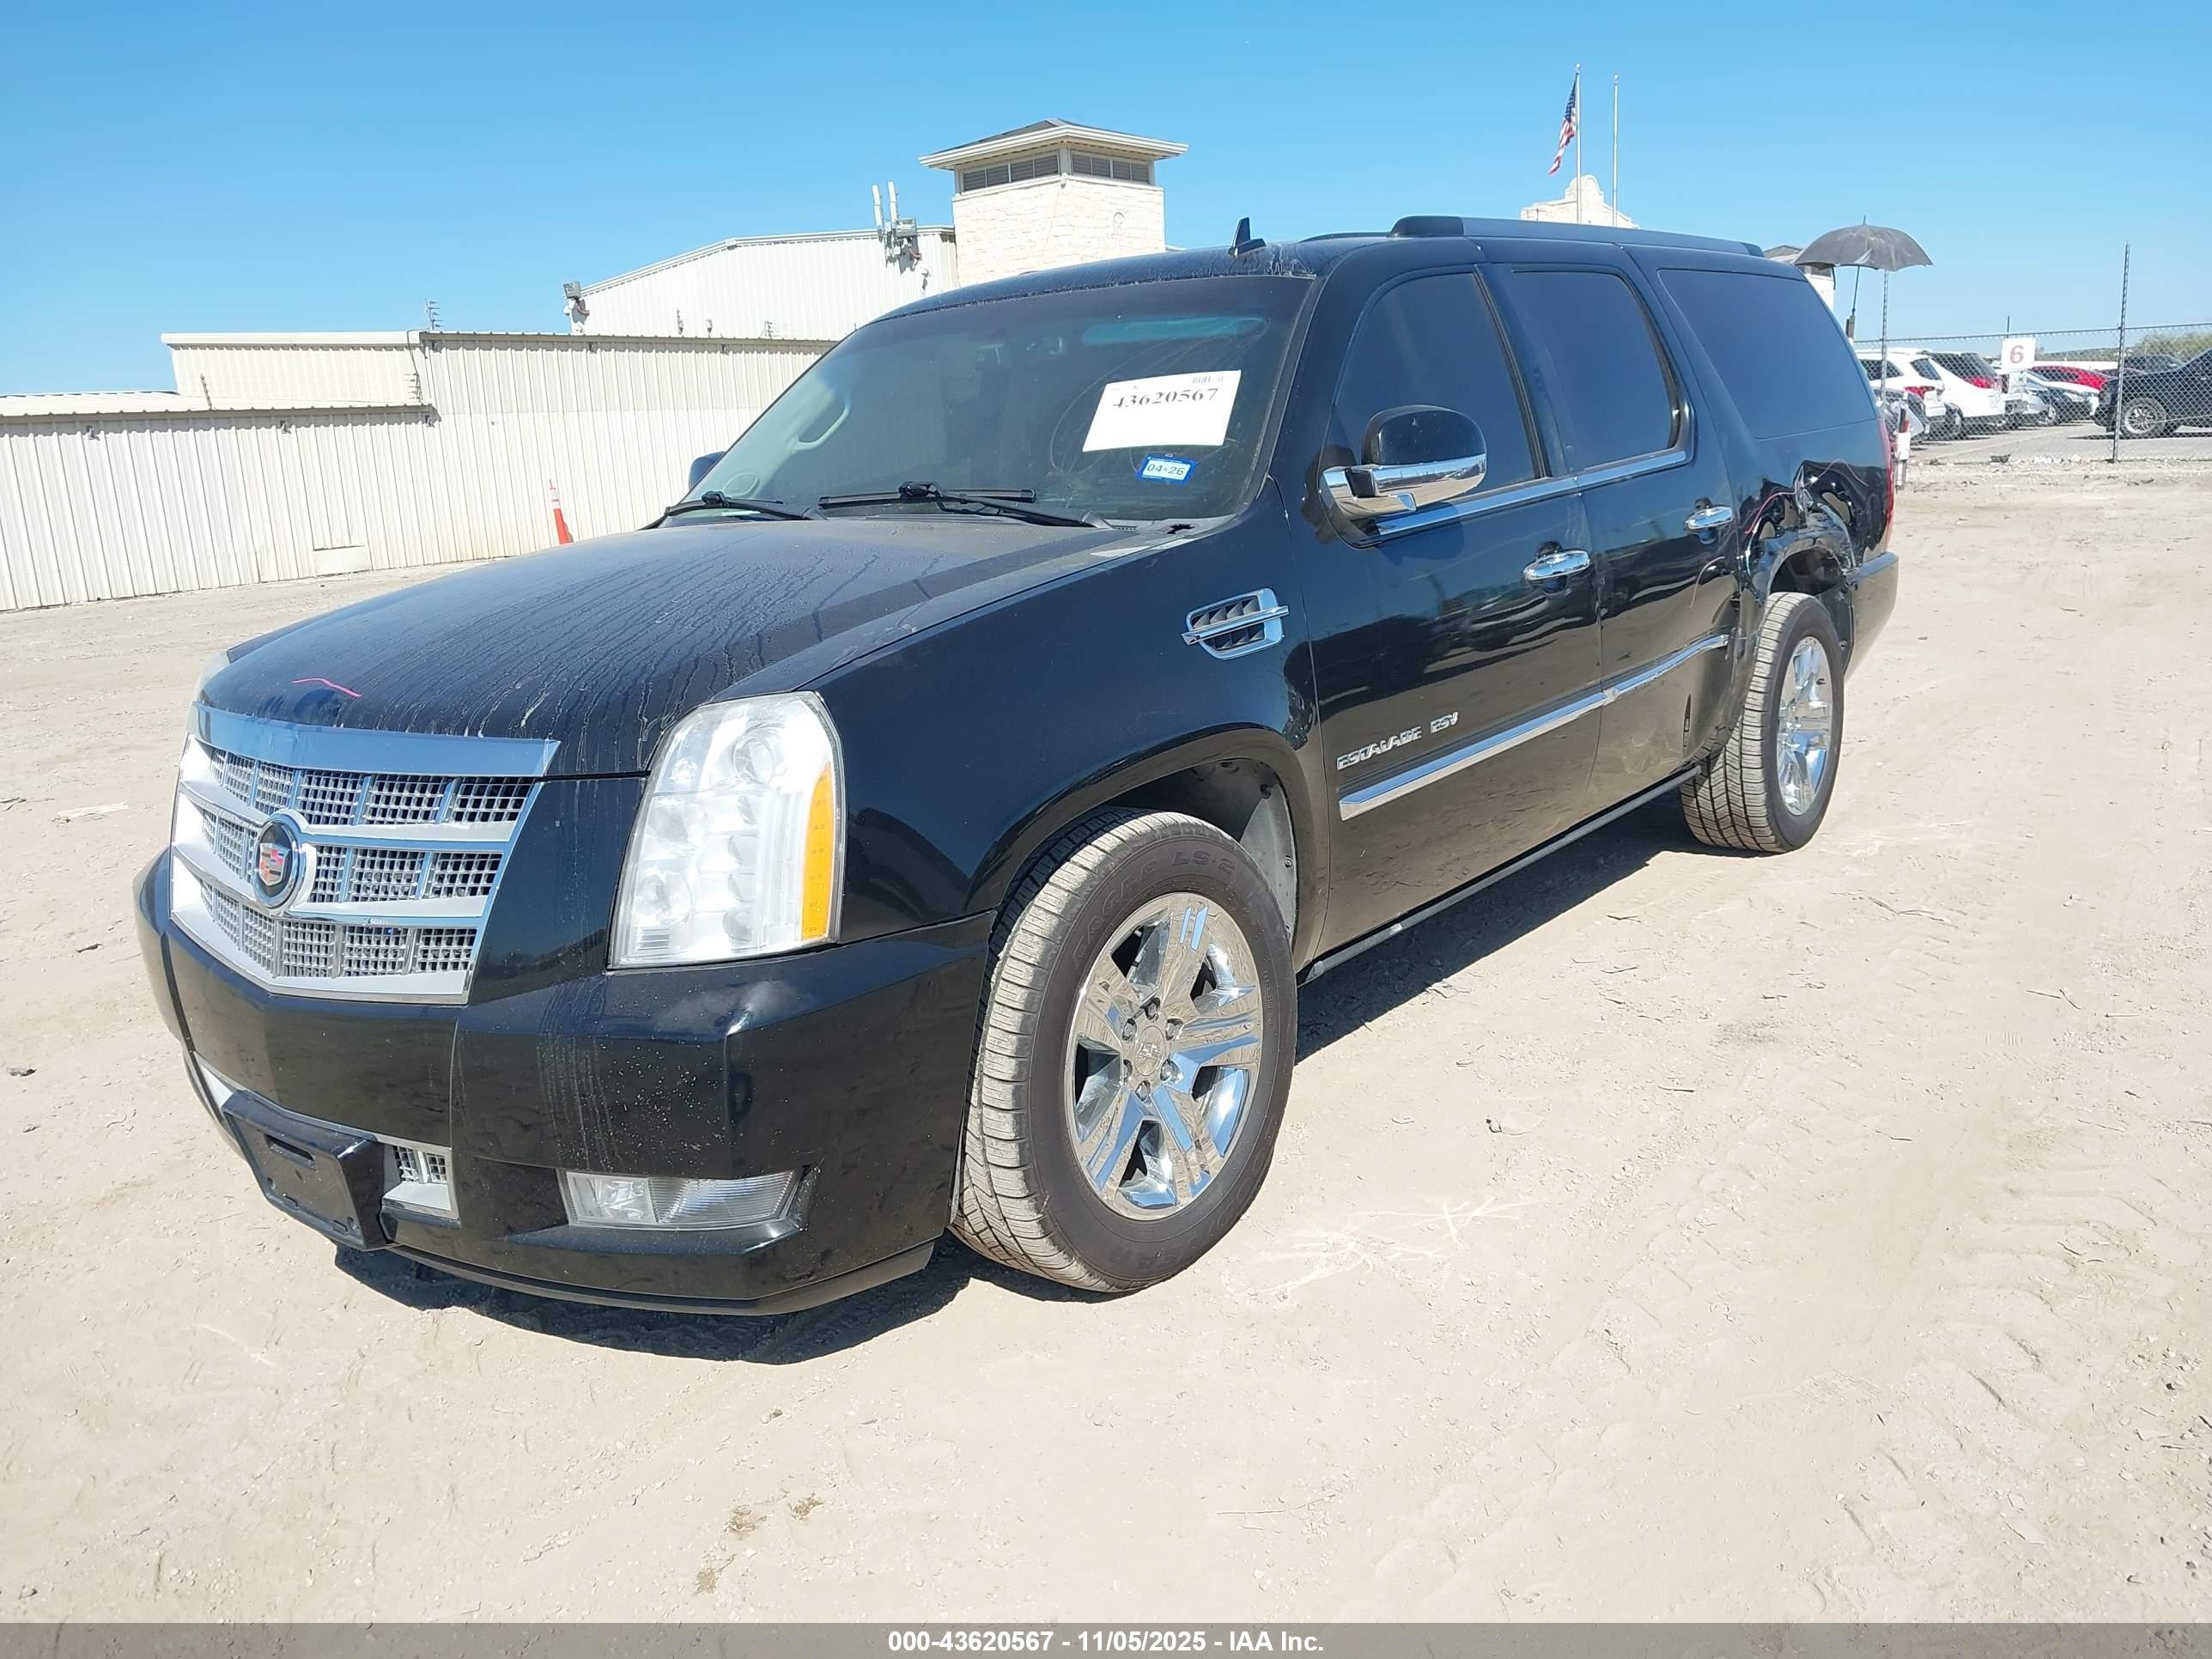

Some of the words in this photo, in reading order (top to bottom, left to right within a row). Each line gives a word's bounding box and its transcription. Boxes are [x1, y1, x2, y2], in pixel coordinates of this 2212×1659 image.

[2009, 344, 2025, 364] 6
[1113, 387, 1219, 408] 43620567
[1336, 726, 1423, 770] ESCALADE
[1430, 711, 1459, 734] ESV
